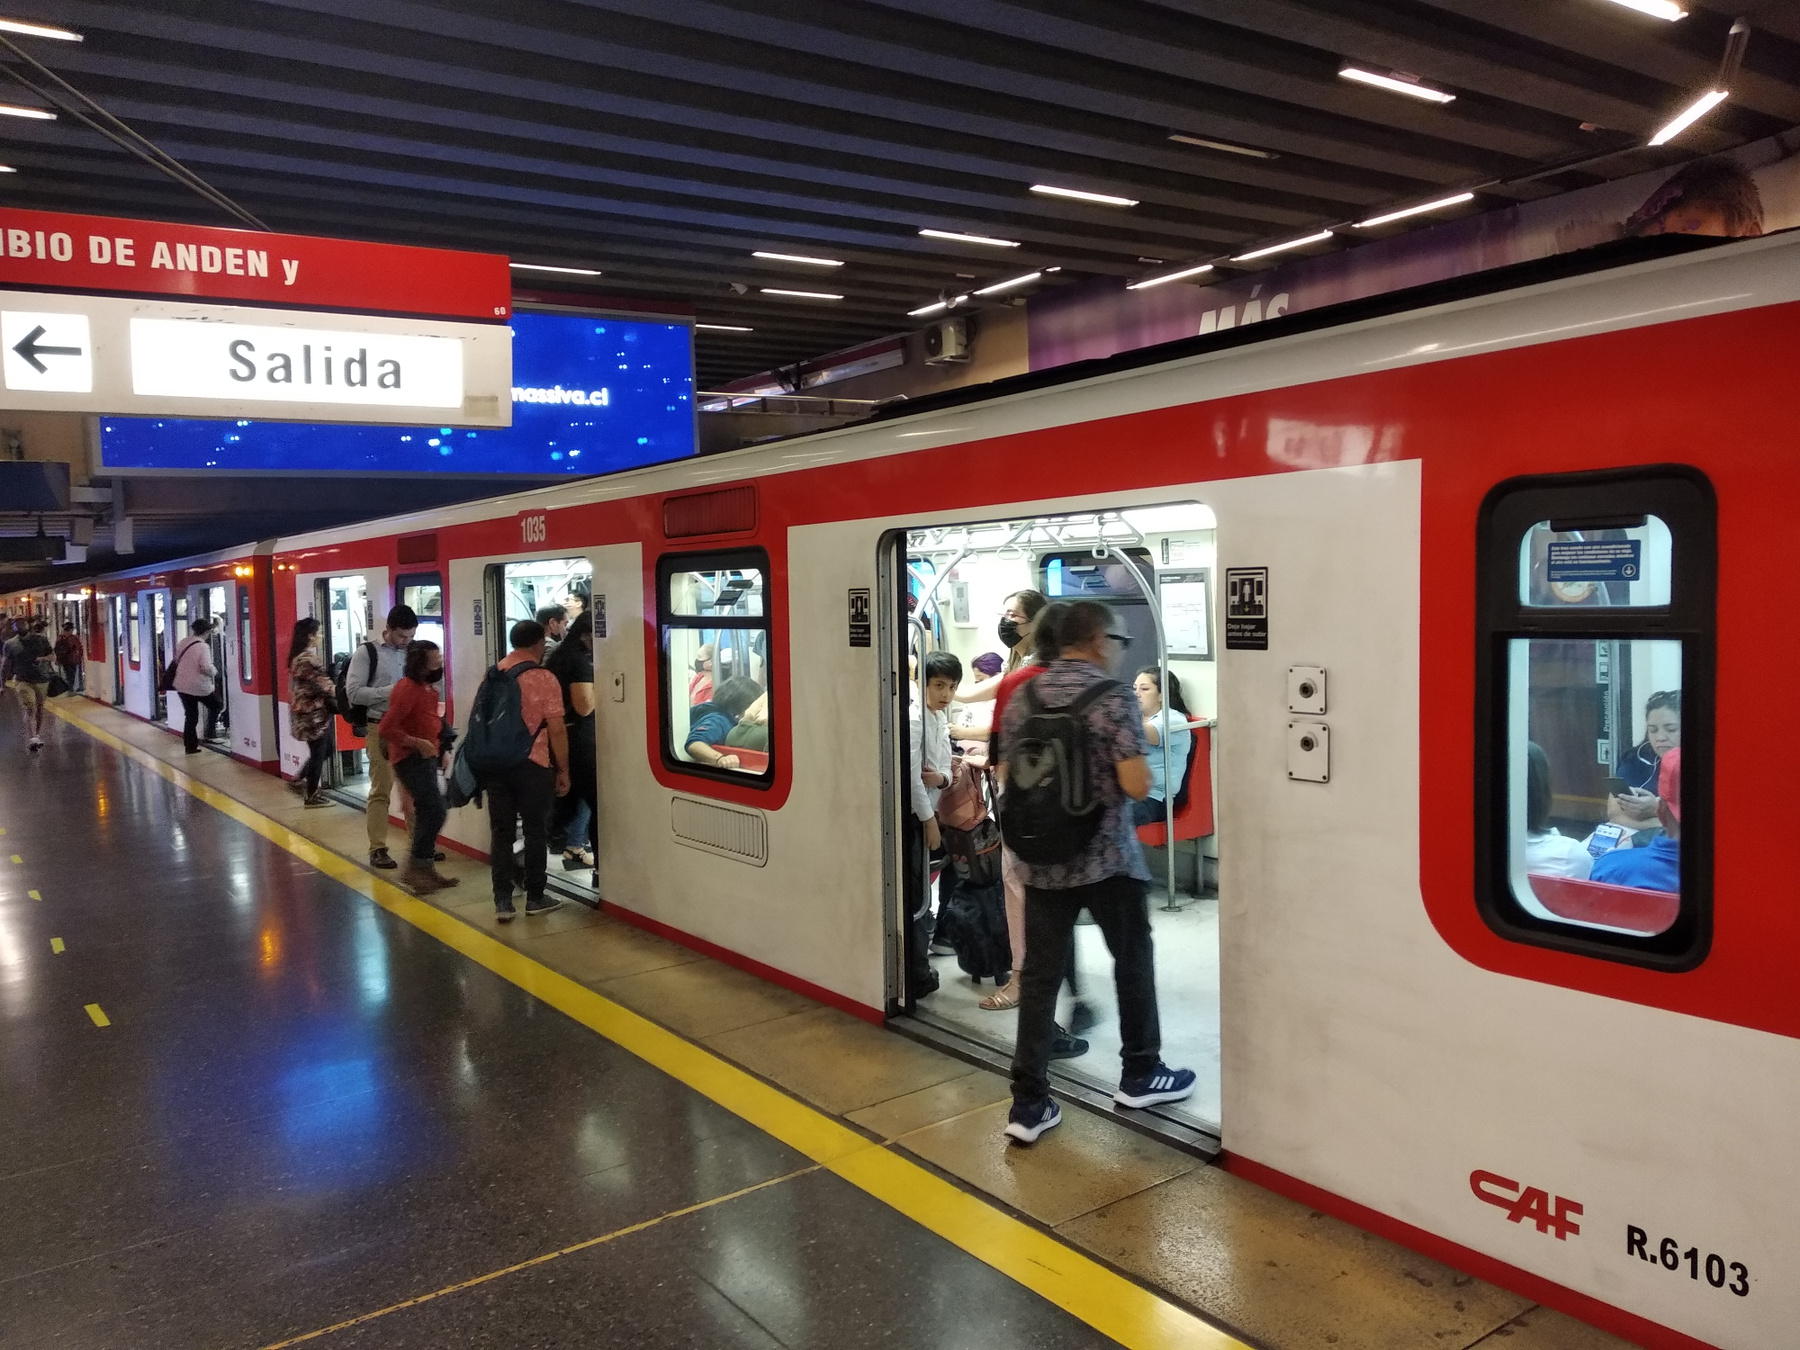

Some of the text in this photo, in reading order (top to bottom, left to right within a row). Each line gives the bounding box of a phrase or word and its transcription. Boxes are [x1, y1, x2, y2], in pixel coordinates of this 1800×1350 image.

[0, 228, 299, 285] BIO DE ANDEN y
[229, 339, 403, 388] Salida
[520, 515, 546, 543] 1035
[1469, 1169, 1750, 1297] CAF R.6103
